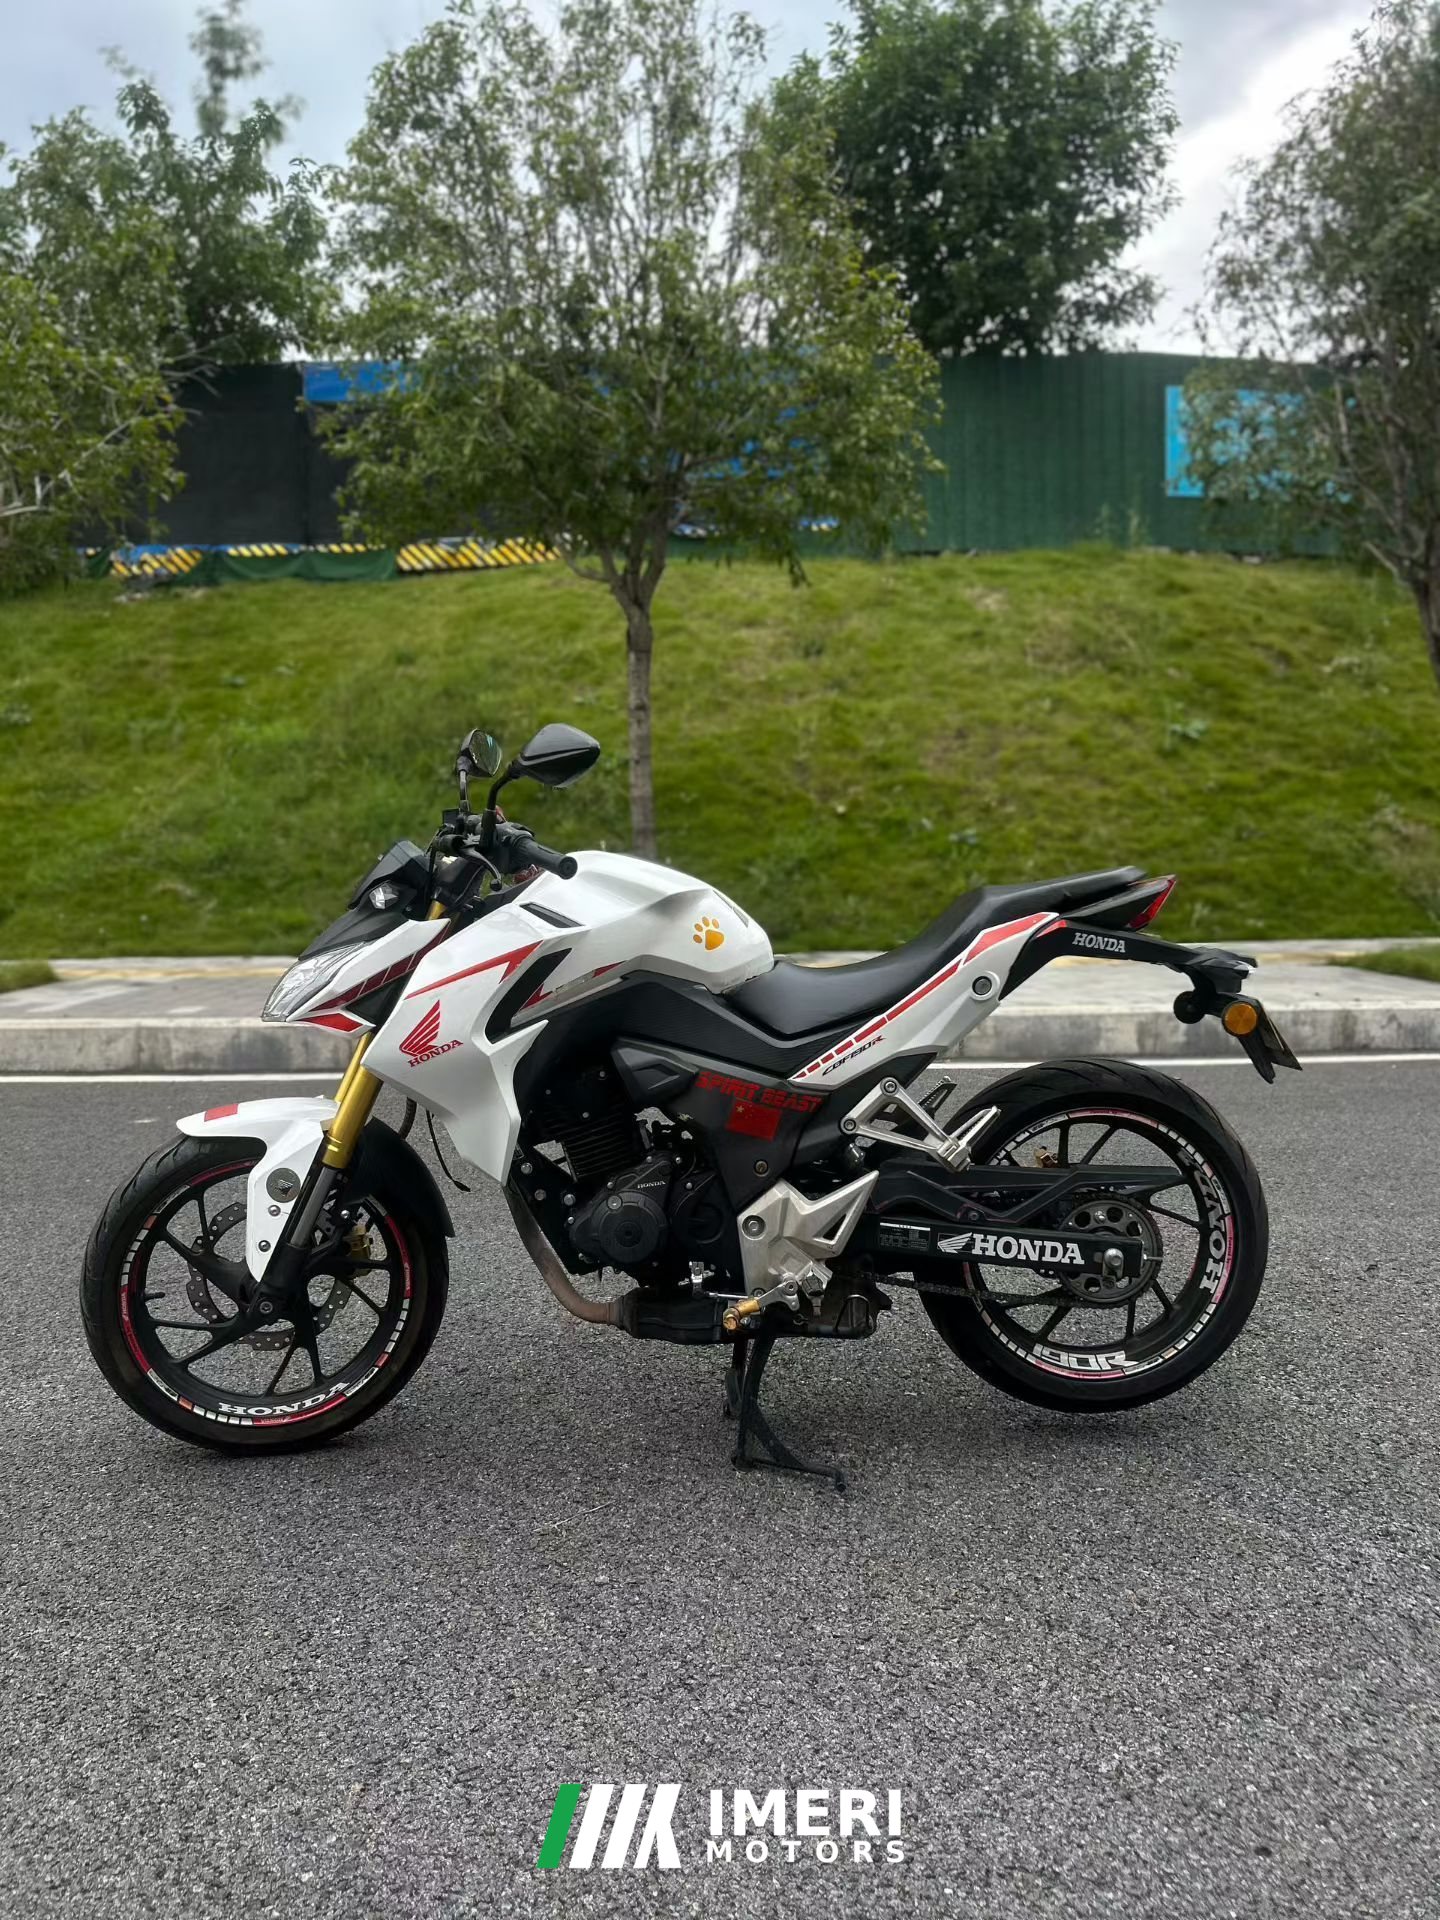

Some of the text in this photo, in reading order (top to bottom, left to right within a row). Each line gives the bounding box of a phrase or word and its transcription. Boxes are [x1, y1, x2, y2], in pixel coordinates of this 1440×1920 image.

[1072, 932, 1126, 953] HONDA
[408, 1040, 463, 1067] HONDA
[696, 1071, 822, 1113] SPIRIT BEAST
[637, 1180, 667, 1189] HONDA
[972, 1233, 1085, 1265] HONDA
[218, 1382, 350, 1415] HONDA
